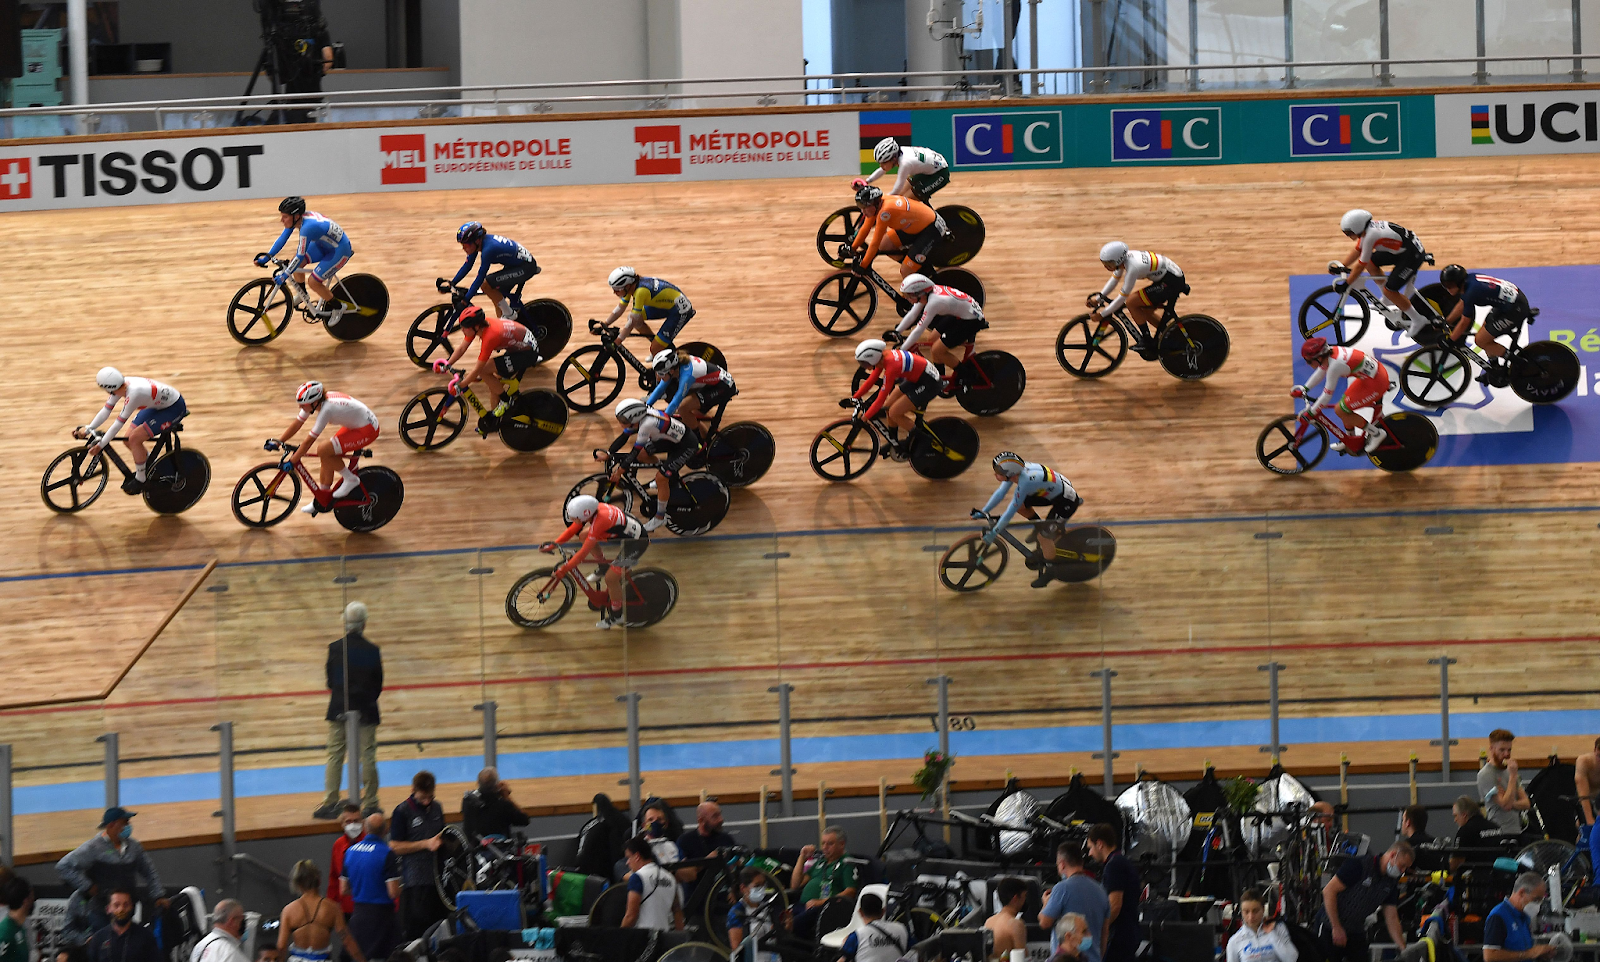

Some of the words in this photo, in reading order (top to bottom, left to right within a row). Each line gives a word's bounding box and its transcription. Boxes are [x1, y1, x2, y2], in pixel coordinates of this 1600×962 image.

[1302, 112, 1388, 147] CIC
[1494, 102, 1598, 144] UCI
[689, 129, 830, 151] MÉTROPOLE
[965, 121, 1050, 156] CIC
[1123, 117, 1209, 151] CIC
[381, 149, 426, 169] MEL
[434, 138, 571, 160] MÉTROPOLE
[636, 141, 681, 160] MEL
[689, 151, 773, 165] EUROPÉENNE
[777, 151, 793, 162] DE
[797, 150, 830, 162] LILLE
[38, 145, 265, 198] TISSOT
[434, 160, 515, 173] EUROPÉENNE
[519, 160, 535, 171] DE
[539, 159, 572, 170] LILLE
[921, 176, 945, 194] MEXICO
[871, 271, 897, 298] KOGA
[1359, 288, 1391, 313] FELT
[1492, 318, 1515, 332] USA
[504, 355, 515, 373] HUN
[467, 393, 484, 413] LOOK
[1349, 391, 1380, 409] BELARUS
[344, 437, 370, 449] POLSKA
[873, 419, 899, 446] FUJI
